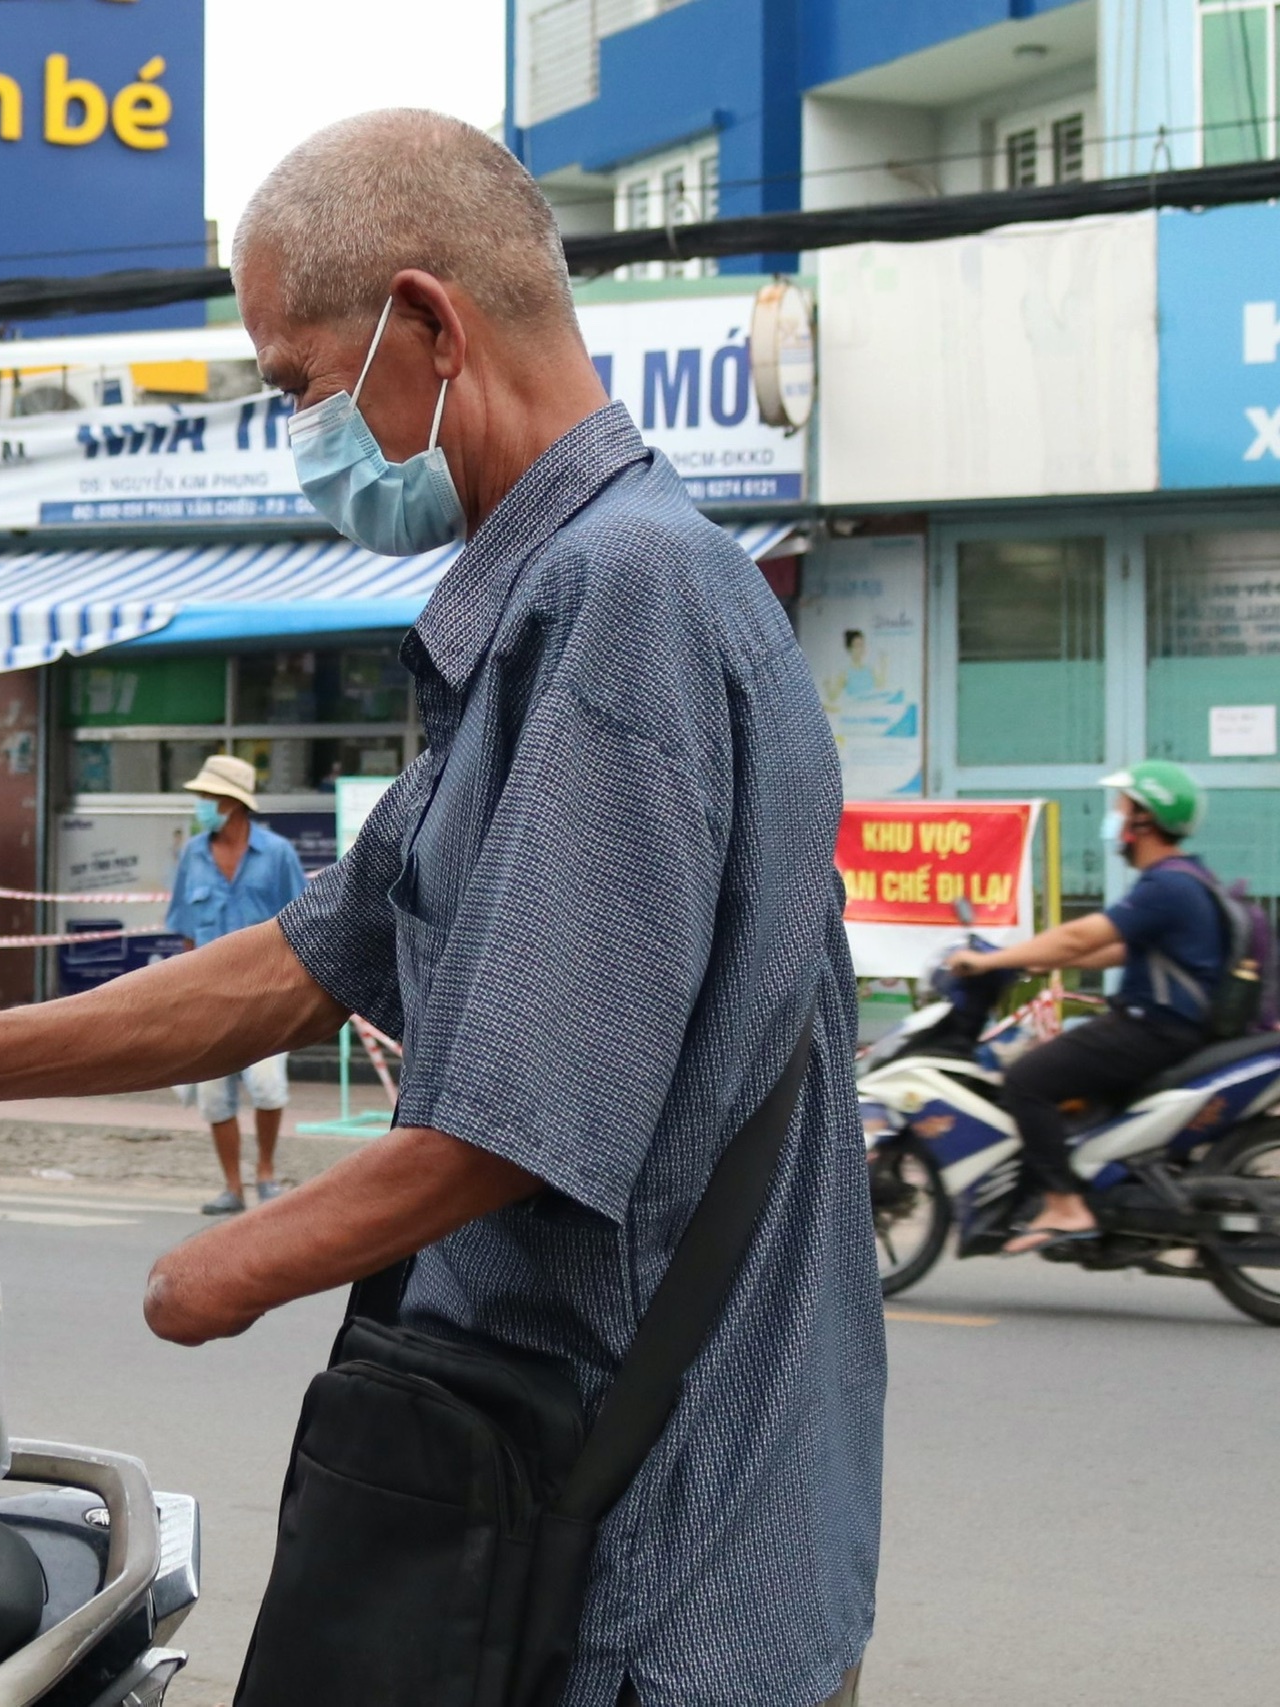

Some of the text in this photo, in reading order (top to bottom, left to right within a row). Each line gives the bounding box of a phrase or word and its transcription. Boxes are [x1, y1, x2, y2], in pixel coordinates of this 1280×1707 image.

[45, 53, 172, 150] bé
[642, 326, 762, 430] MỚ
[862, 818, 972, 861] KHU VỰC
[882, 863, 933, 904] CHẾ
[971, 872, 1012, 912] LẠI
